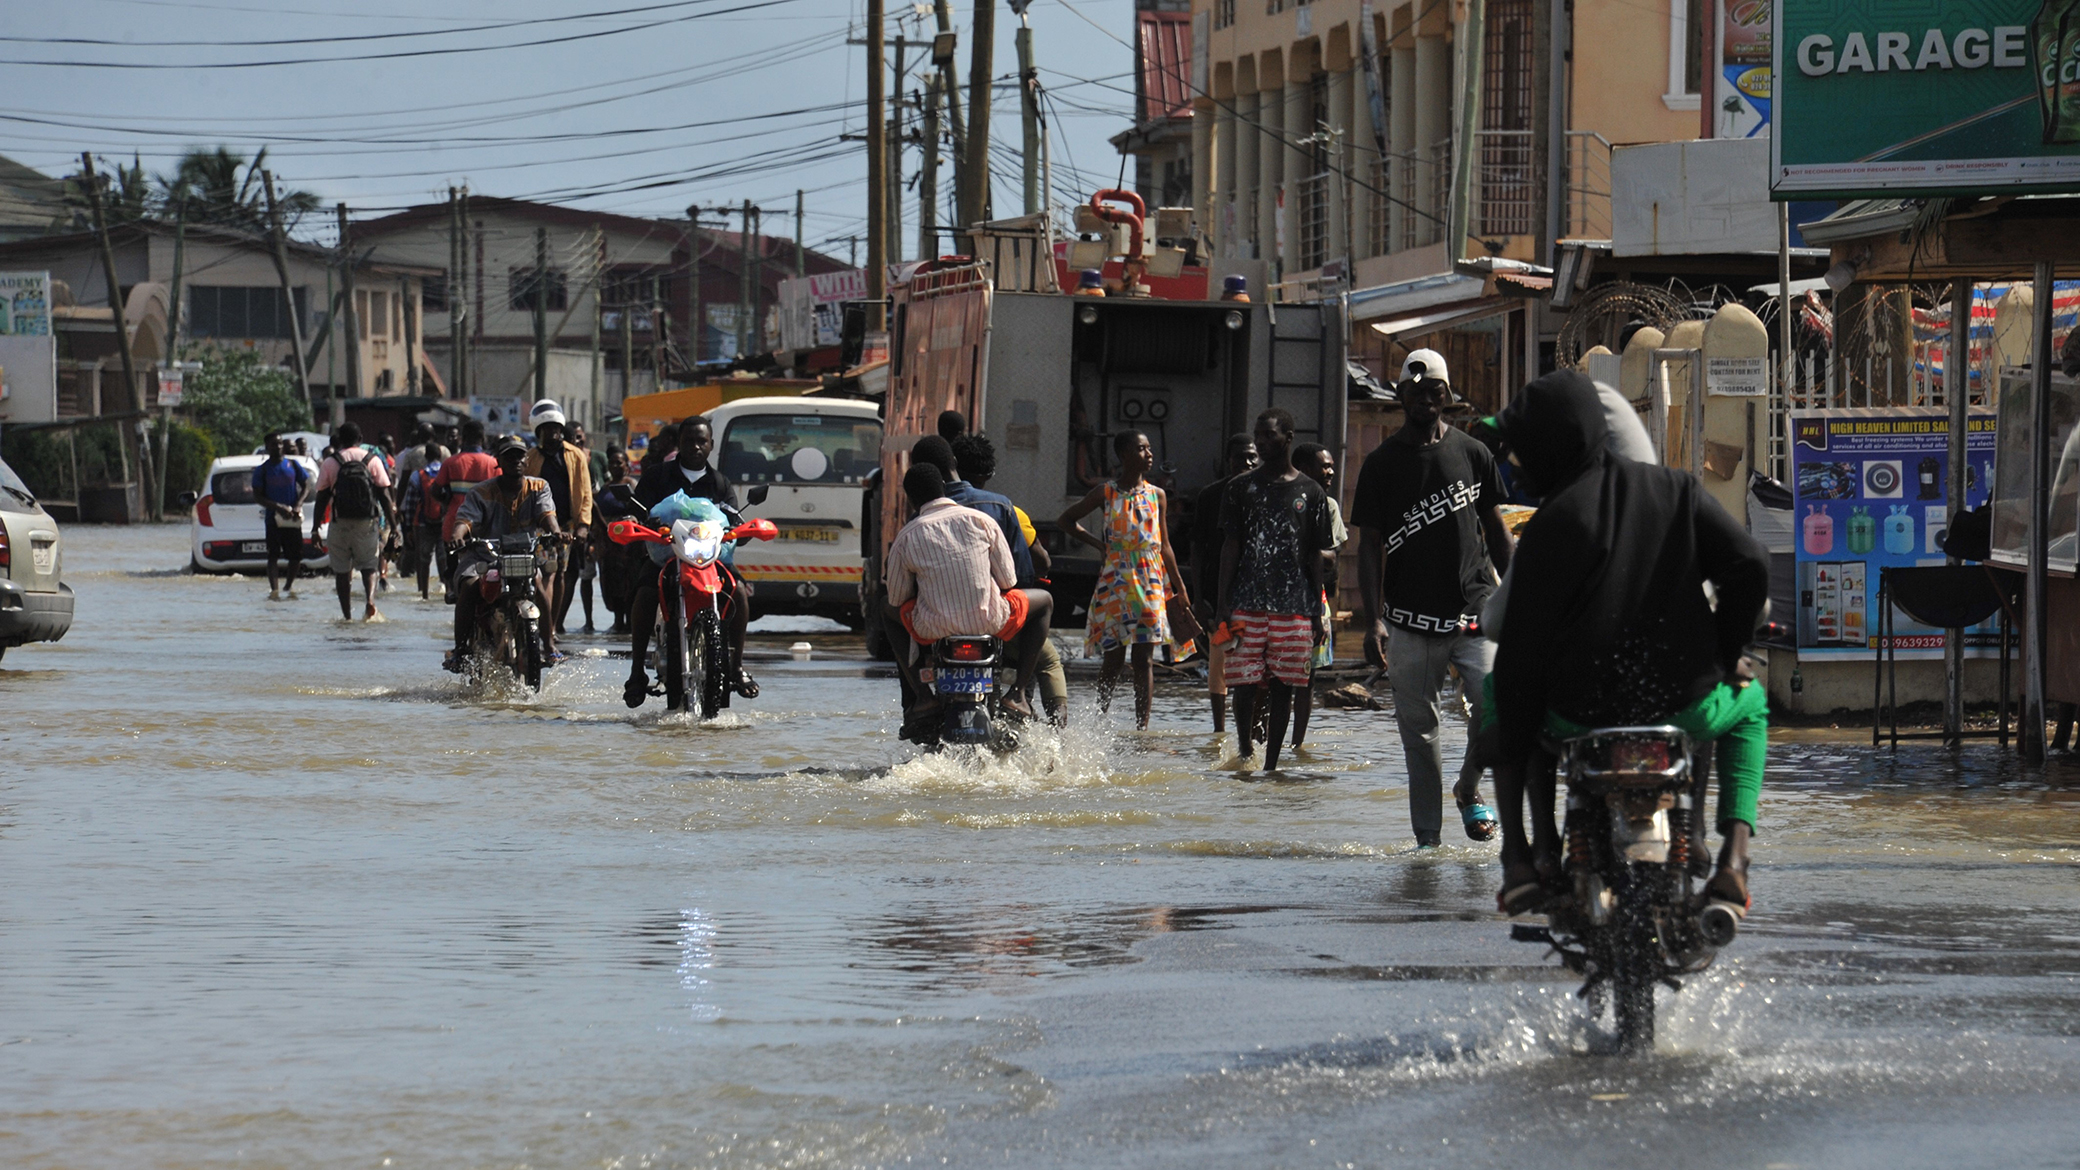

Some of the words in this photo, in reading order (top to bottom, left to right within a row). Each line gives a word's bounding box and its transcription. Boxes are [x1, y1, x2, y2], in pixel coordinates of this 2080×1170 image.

[1796, 25, 2027, 77] GARAGE
[812, 270, 867, 295] WITH
[1802, 426, 1819, 436] HHL
[1830, 422, 1854, 434] HIGH
[1855, 422, 1891, 434] HEAVEN
[1892, 421, 1931, 433] LIMITED
[1932, 421, 1949, 433] SAL
[1968, 420, 1982, 432] ND
[1883, 442, 1920, 450] conditioning
[1402, 480, 1466, 522] SENDIFS
[1882, 636, 1946, 648] 09639329
[954, 681, 983, 692] 2739
